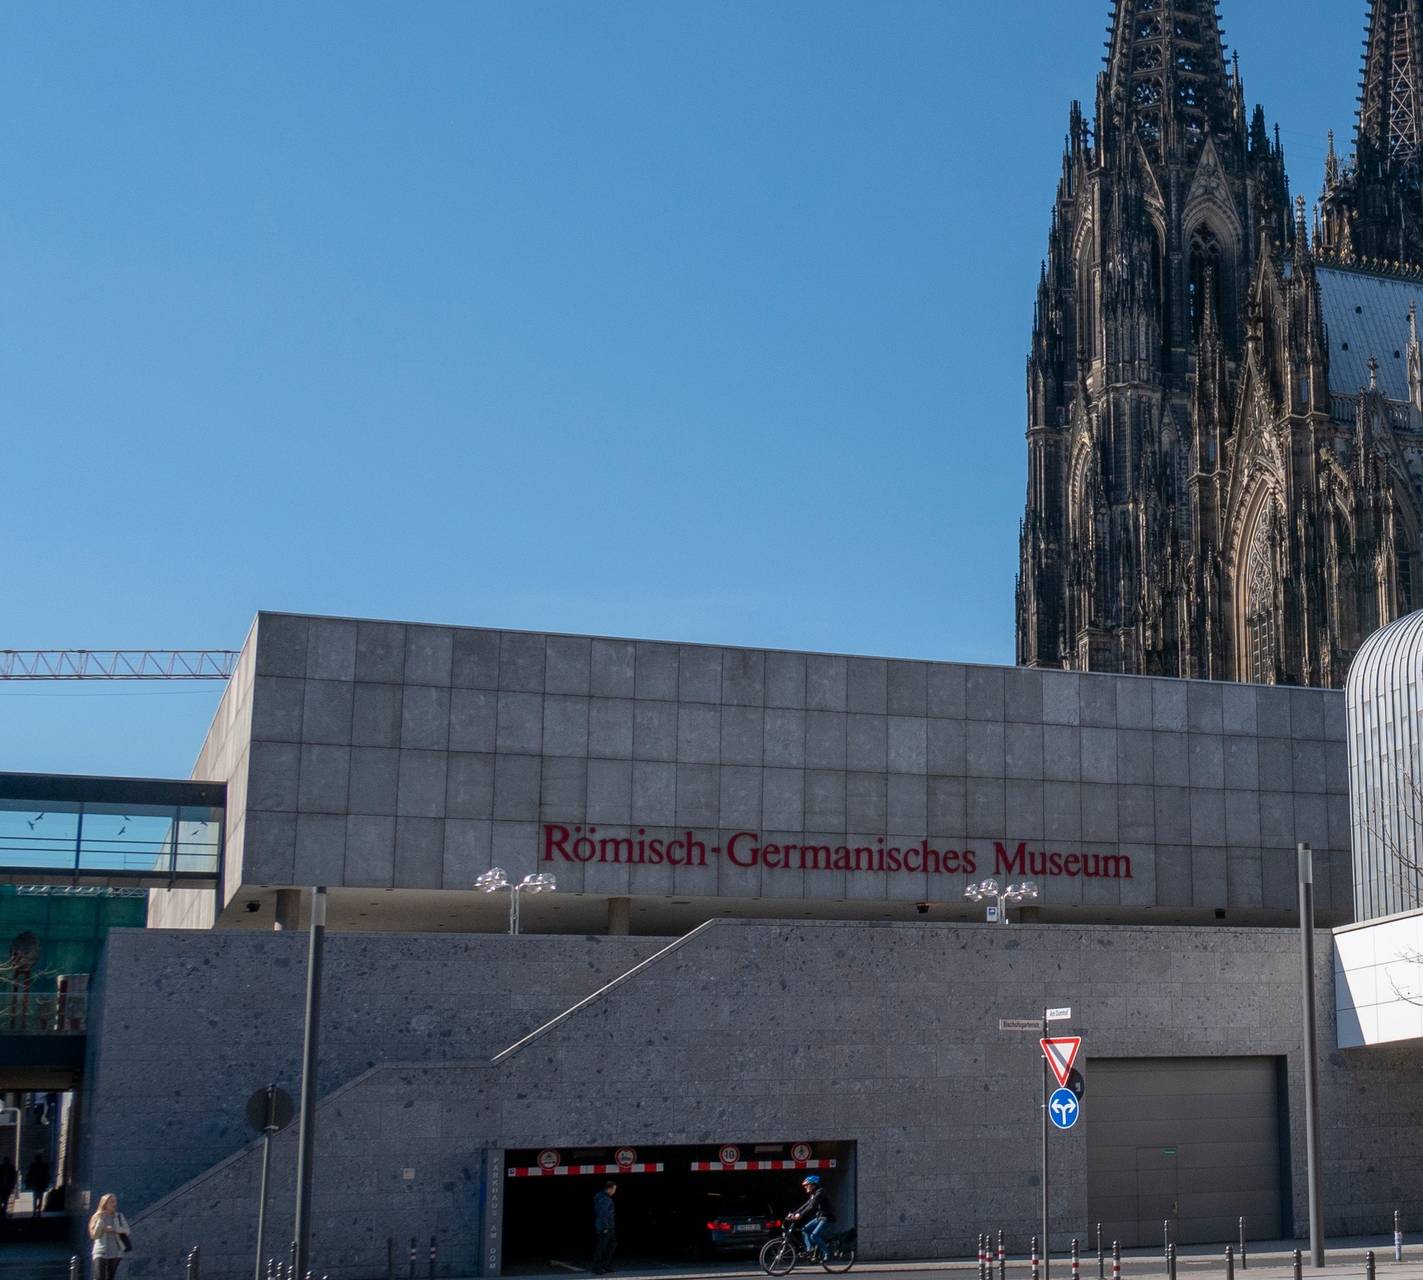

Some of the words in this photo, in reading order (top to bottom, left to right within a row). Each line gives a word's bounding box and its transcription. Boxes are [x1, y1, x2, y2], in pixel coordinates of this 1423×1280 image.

[543, 824, 977, 874] Römisch-Germanisches
[993, 841, 1134, 878] Museum
[725, 1150, 735, 1160] 10
